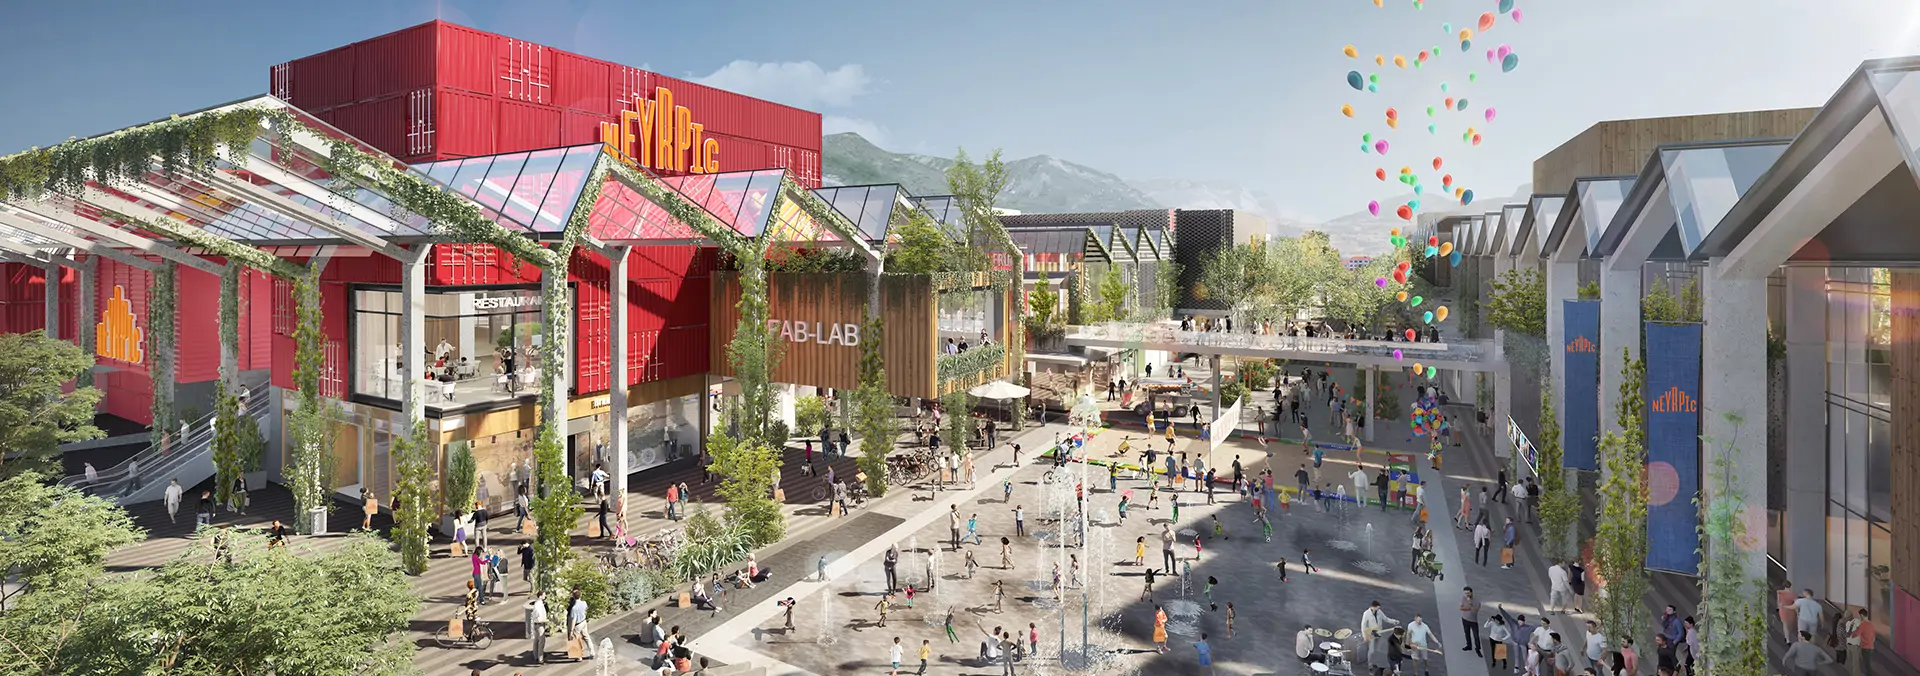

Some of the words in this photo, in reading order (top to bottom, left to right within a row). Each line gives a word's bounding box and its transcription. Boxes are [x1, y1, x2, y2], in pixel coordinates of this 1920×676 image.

[600, 86, 720, 174] NEYRPIC
[767, 319, 860, 347] FAB-LAB
[1566, 335, 1596, 353] NEYRPIC
[1651, 386, 1697, 412] NEYRPIC
